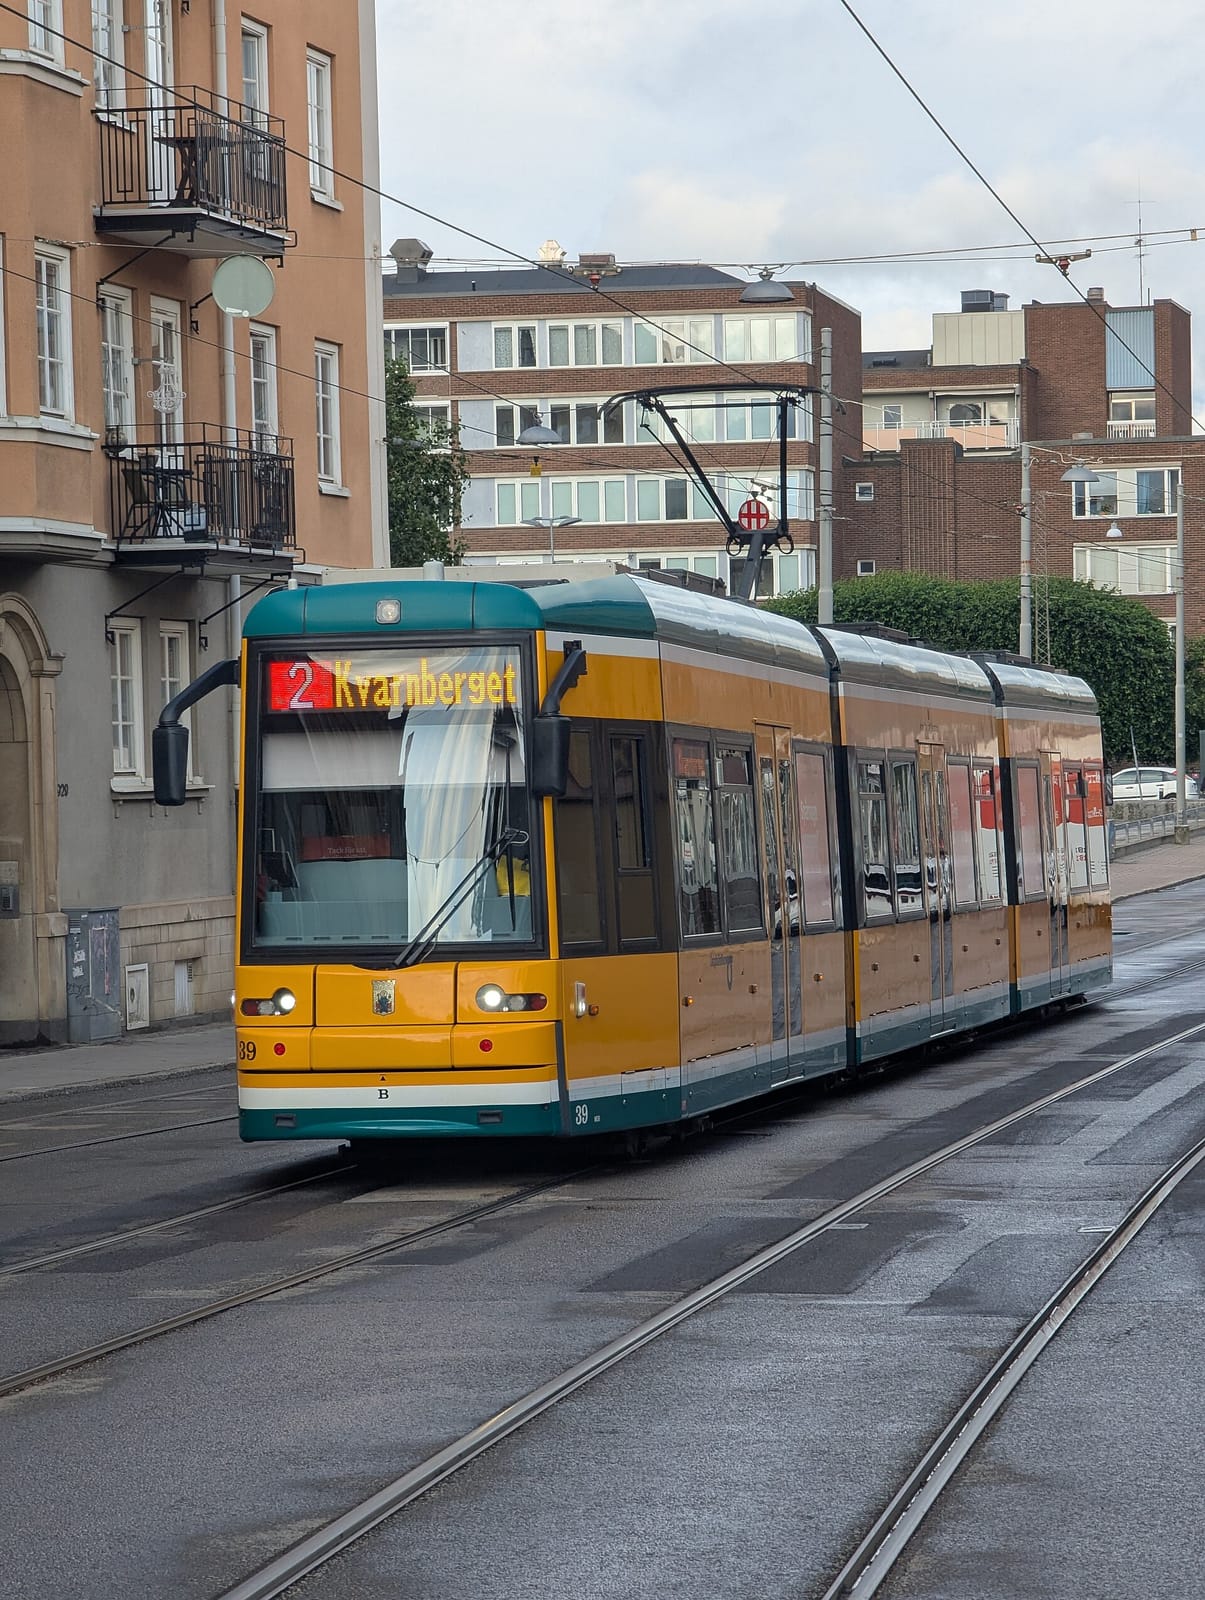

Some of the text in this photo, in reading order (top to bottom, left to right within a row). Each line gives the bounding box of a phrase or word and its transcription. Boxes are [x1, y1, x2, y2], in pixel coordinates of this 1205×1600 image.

[288, 658, 517, 709] 2 Kvarnberget
[239, 1040, 257, 1061] 39
[377, 1088, 389, 1100] B
[575, 1103, 588, 1125] 39
